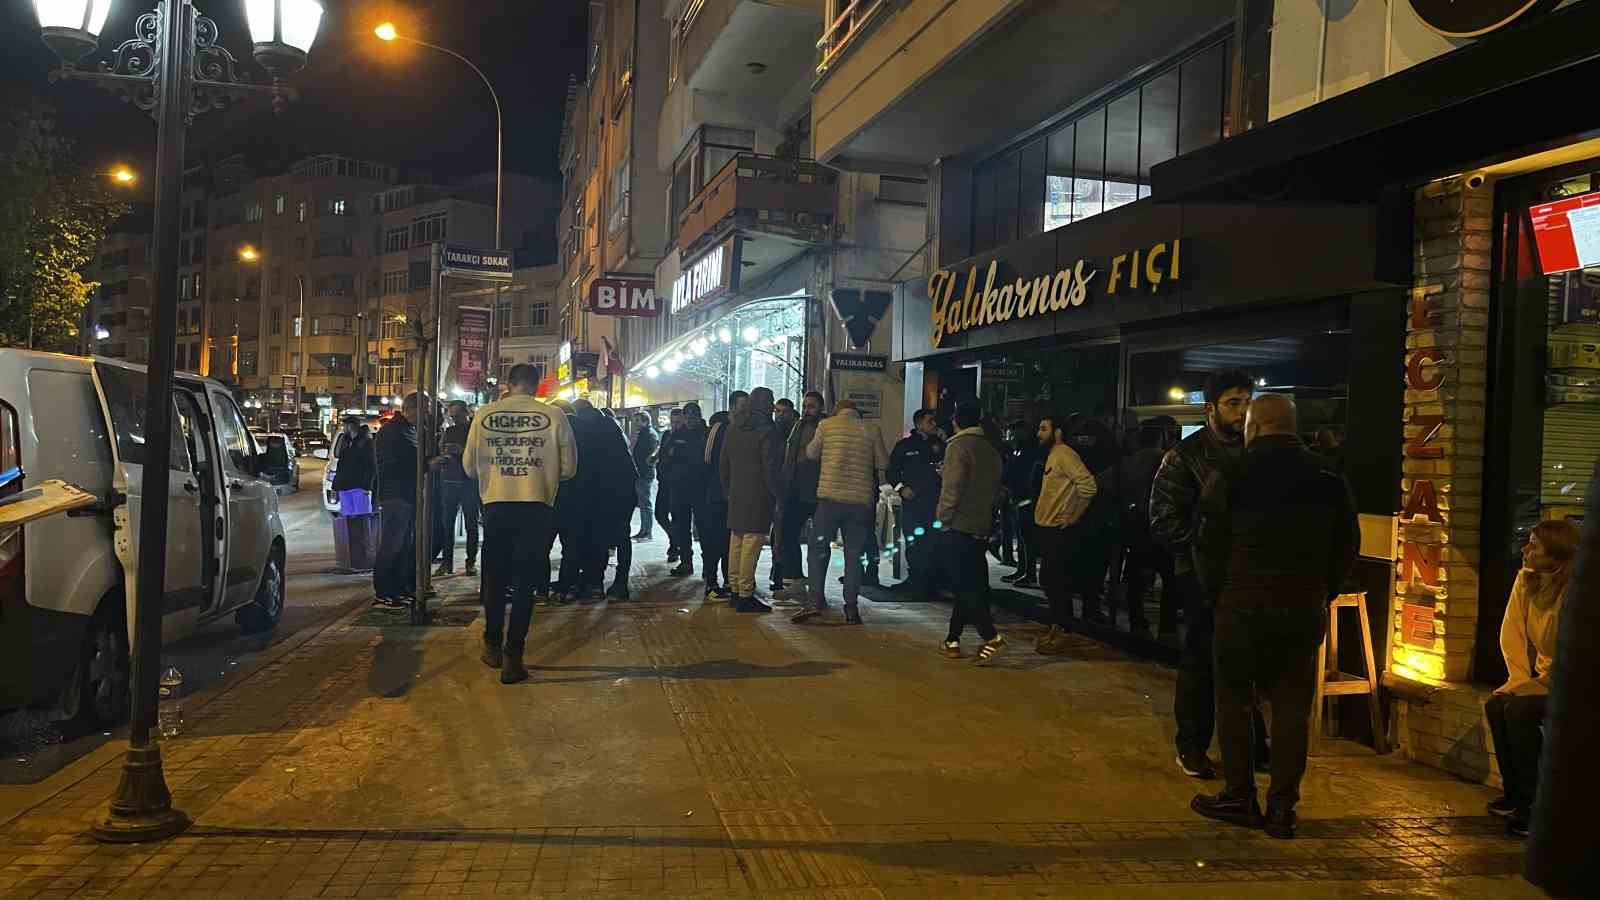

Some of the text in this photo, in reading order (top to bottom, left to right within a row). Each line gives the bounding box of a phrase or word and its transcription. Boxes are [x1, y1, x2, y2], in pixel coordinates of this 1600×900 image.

[482, 256, 508, 266] SOKAK
[1107, 239, 1181, 295] FIÇI
[597, 280, 656, 311] BİM
[488, 414, 542, 428] HGHRS
[1402, 285, 1446, 648] ECZANE
